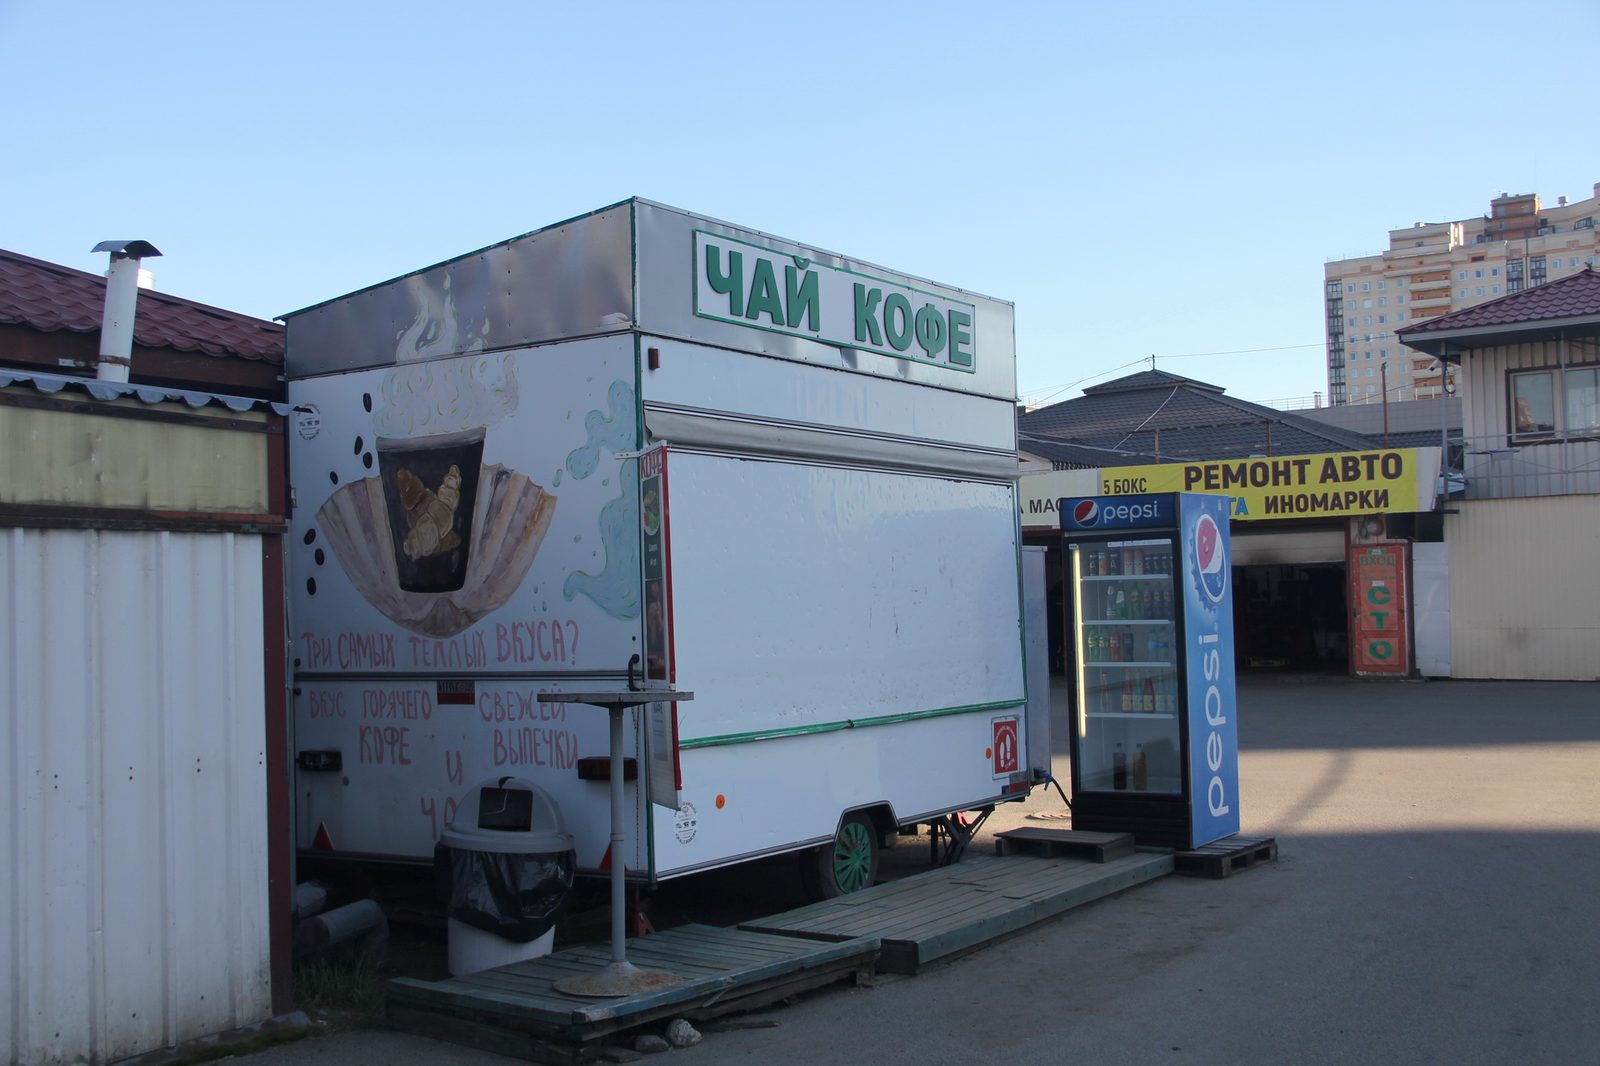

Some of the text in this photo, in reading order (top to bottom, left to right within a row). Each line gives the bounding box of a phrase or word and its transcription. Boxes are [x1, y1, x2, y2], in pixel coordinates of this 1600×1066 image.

[706, 244, 972, 366] ЧАЙ КОФЕ
[1103, 477, 1147, 494] 5 БОКС
[1184, 453, 1403, 491] РЕМОНТ АВТО
[1103, 501, 1159, 524] pepsi
[1264, 489, 1389, 514] ИНОМАРКИ
[338, 632, 396, 670] САМЫХ
[495, 619, 580, 665] ВКУСА?
[309, 688, 432, 720] ВКУС ГОРЯЧЕГО
[1199, 634, 1229, 817] pepsi
[360, 724, 412, 766] КОФЕ
[493, 727, 579, 770] ВЫПЕЧКИ
[446, 750, 464, 786] И
